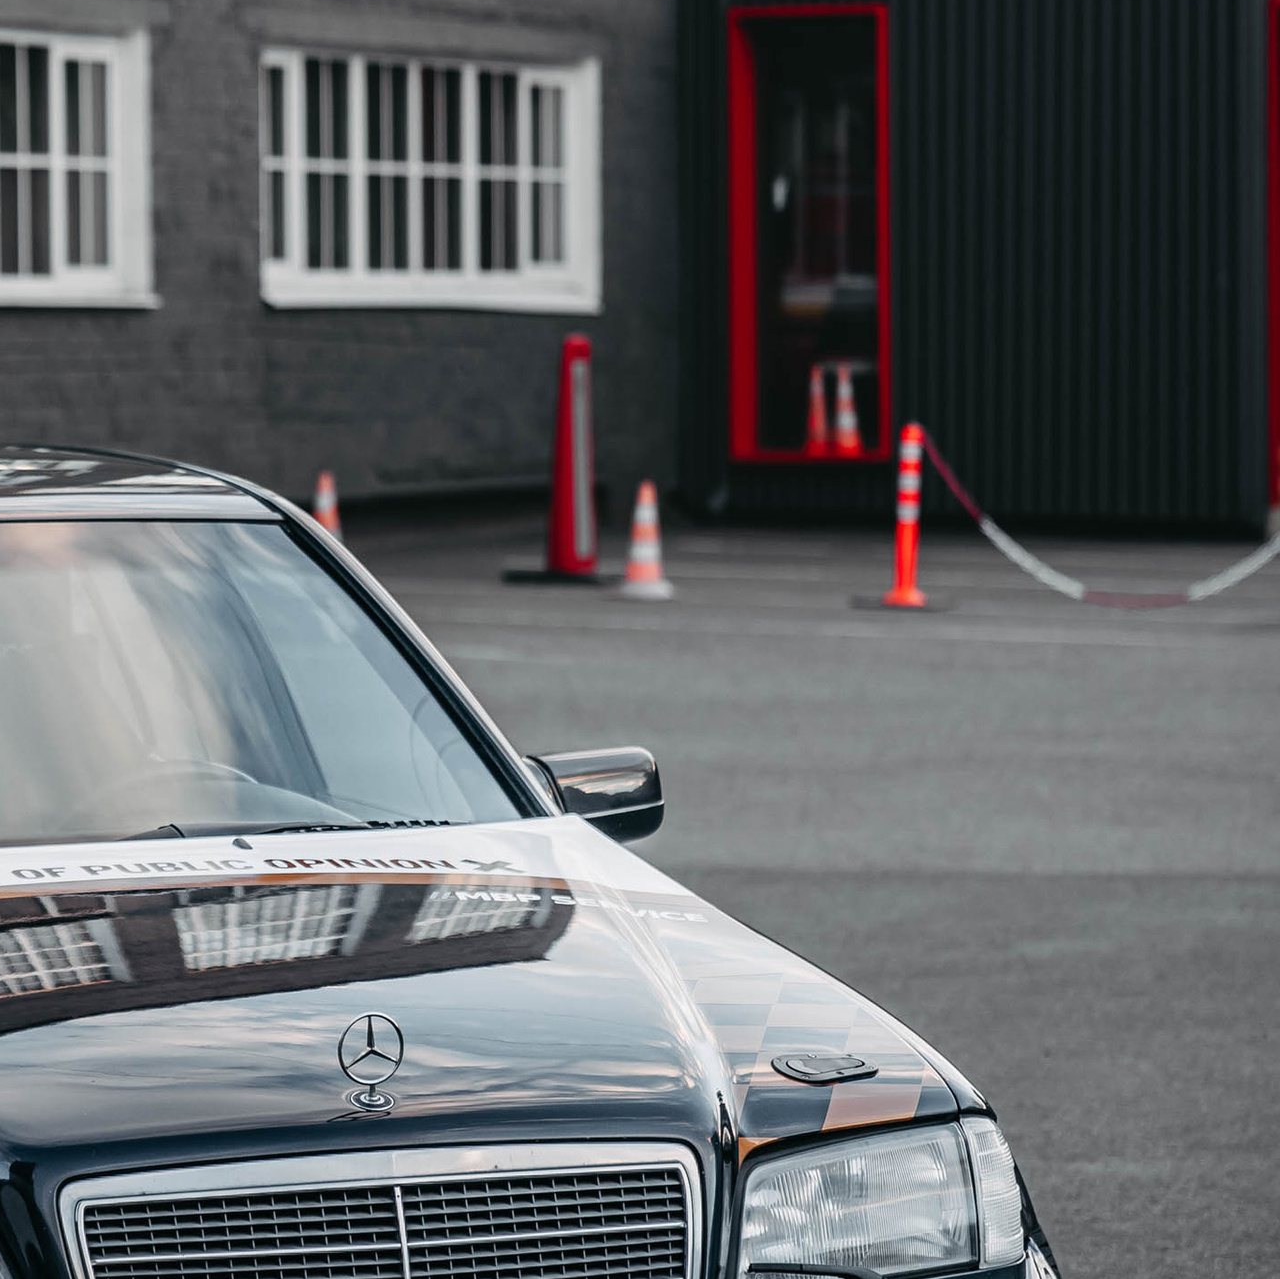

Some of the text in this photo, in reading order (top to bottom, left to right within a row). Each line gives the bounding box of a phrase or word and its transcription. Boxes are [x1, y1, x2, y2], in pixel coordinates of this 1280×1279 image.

[9, 866, 67, 880] OF
[78, 858, 259, 877] PUBLIC
[262, 857, 457, 871] OPINION
